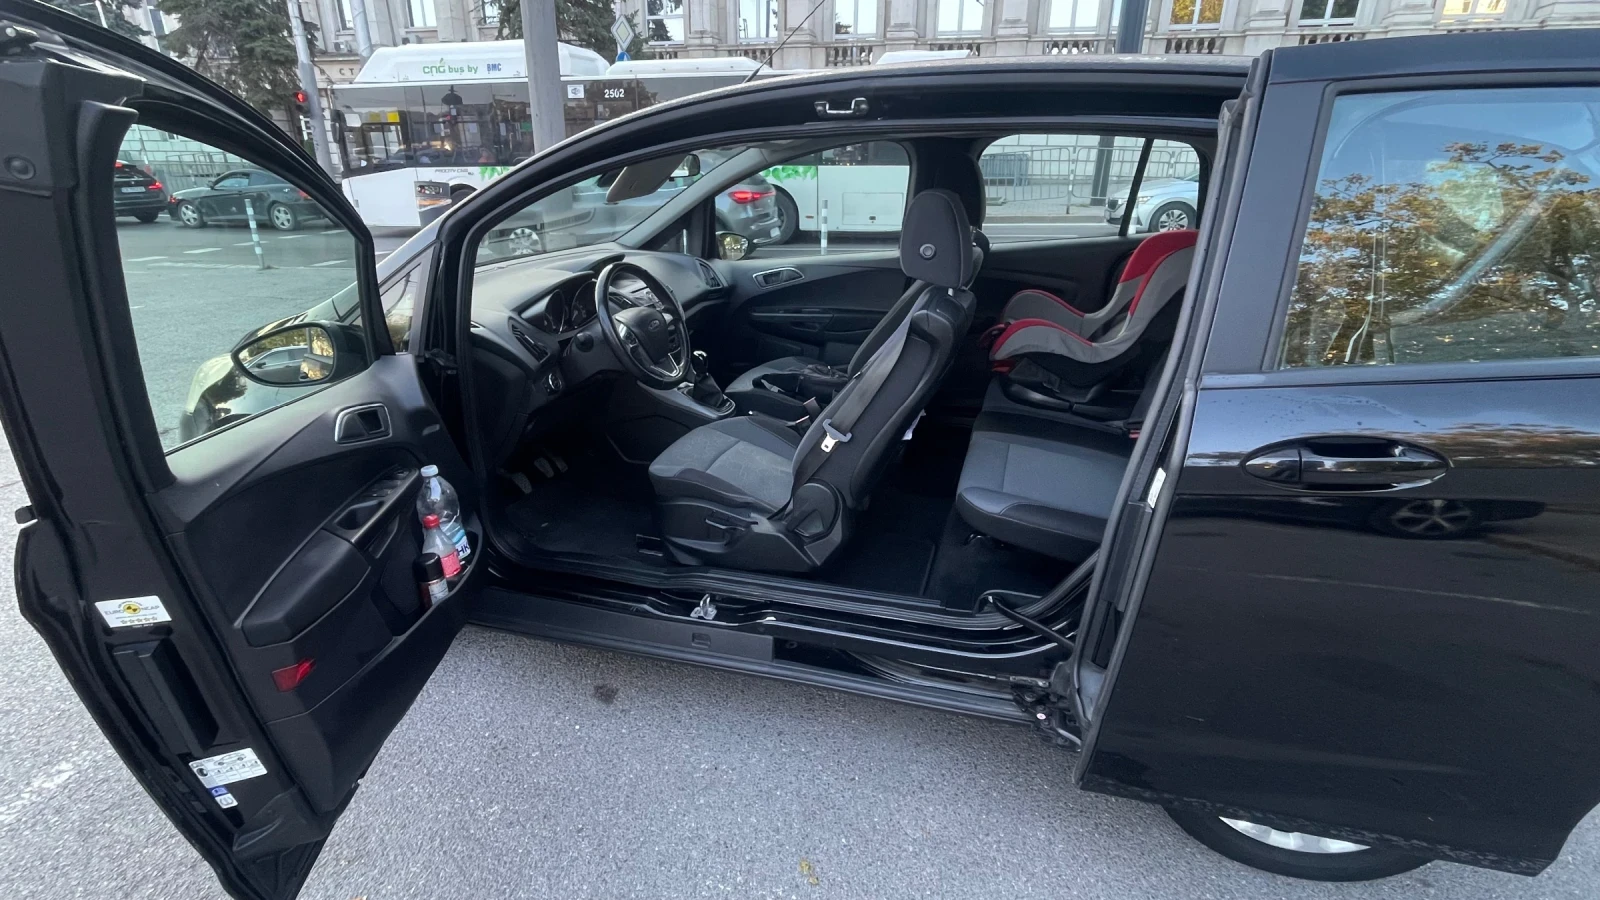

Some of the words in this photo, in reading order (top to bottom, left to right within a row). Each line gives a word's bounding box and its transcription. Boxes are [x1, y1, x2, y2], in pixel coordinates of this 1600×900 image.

[448, 64, 465, 74] bus
[467, 64, 479, 75] by
[486, 63, 502, 72] BMC
[604, 88, 625, 98] 2502
